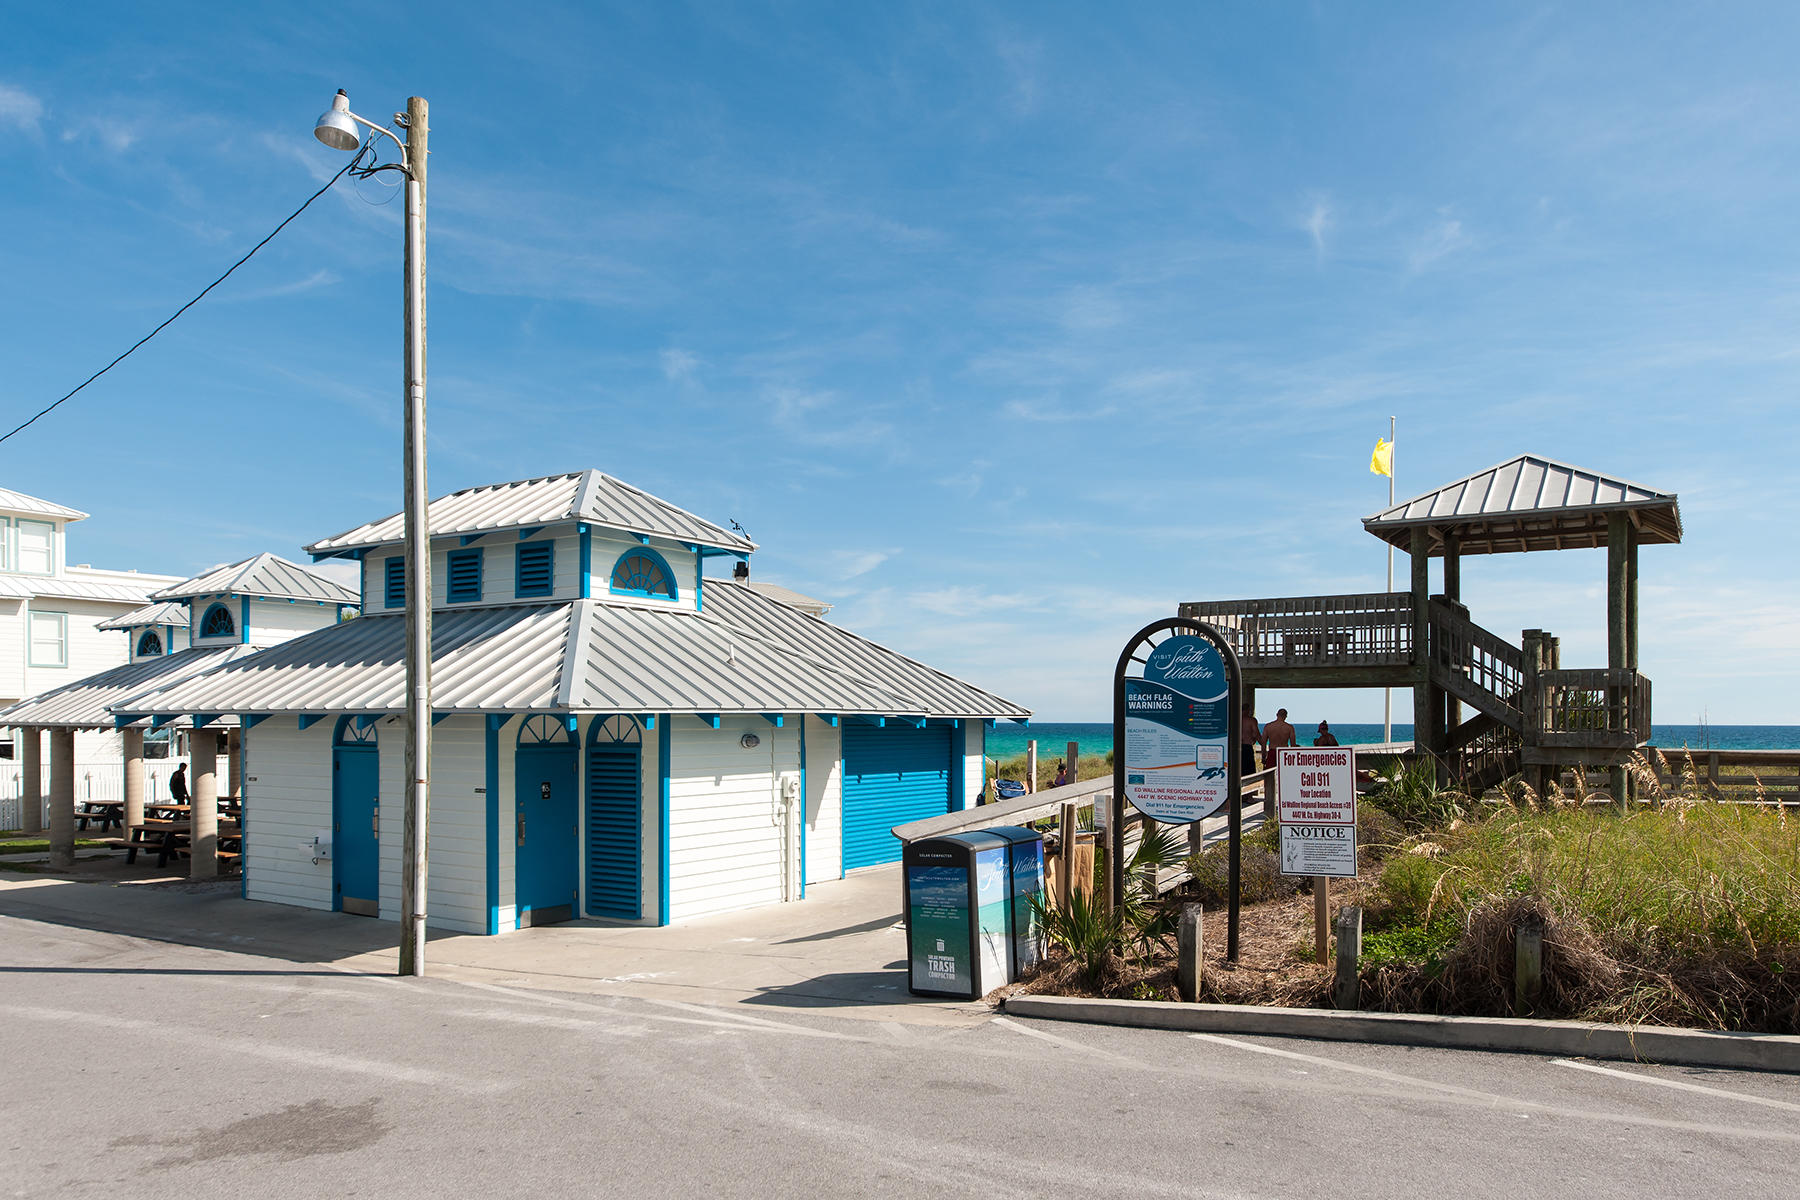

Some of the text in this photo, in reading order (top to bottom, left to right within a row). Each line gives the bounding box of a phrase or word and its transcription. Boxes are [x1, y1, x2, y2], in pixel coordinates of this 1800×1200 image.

[1155, 644, 1209, 670] South
[1163, 664, 1214, 680] Walton
[1128, 693, 1173, 701] BEACH FLAG
[1128, 701, 1173, 710] WARNINGS
[1283, 751, 1347, 768] For Emergencies
[1301, 772, 1330, 787] Call 911
[1300, 789, 1332, 798] Your Location
[1300, 801, 1317, 809] Regional
[1313, 811, 1331, 820] Highway
[1290, 827, 1345, 838] NOTICE
[927, 959, 955, 973] TRASH
[928, 971, 956, 980] COMPACTOR
